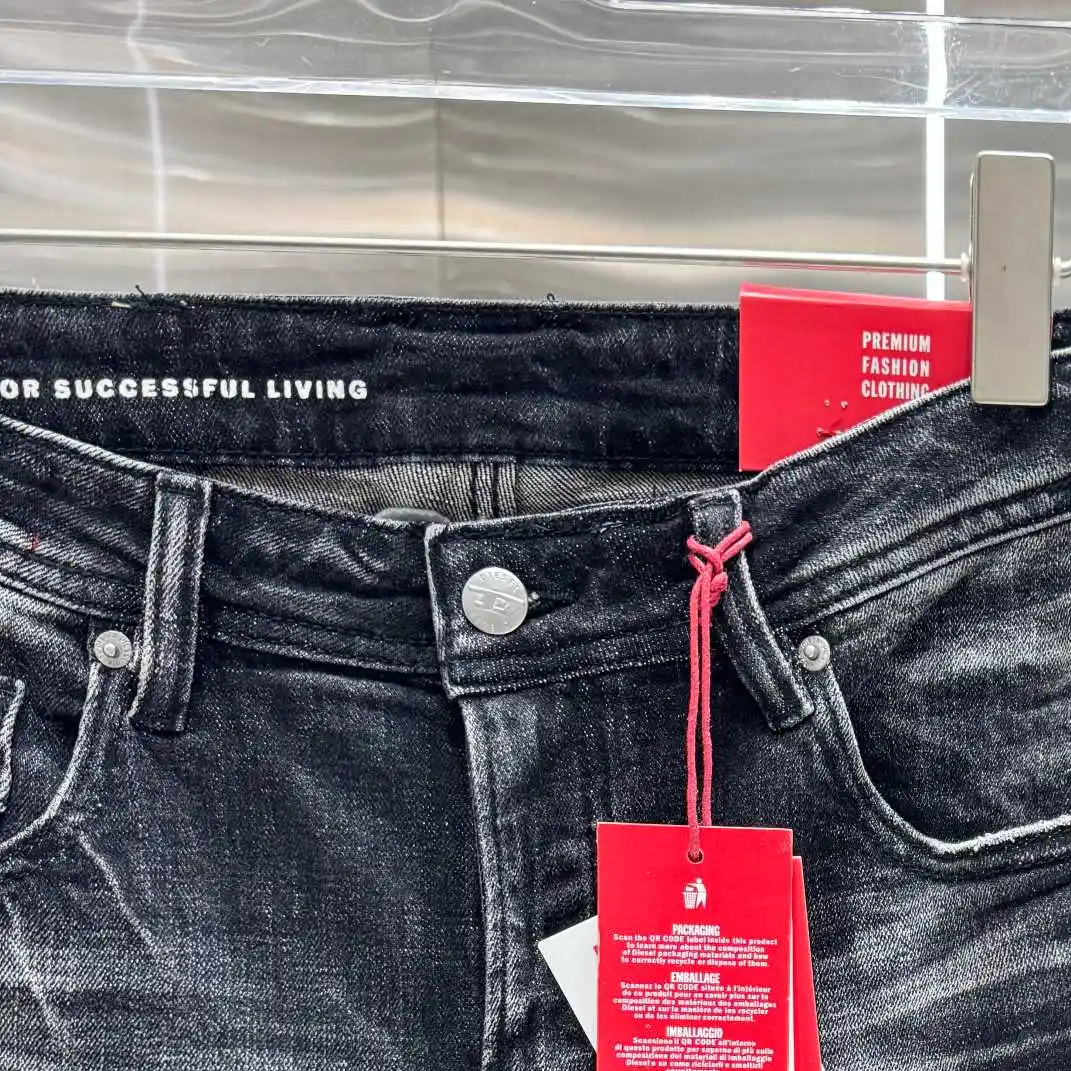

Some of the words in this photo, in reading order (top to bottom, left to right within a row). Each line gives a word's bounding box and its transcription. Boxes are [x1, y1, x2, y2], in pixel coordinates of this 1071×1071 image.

[862, 330, 931, 352] PREMIUM
[862, 356, 930, 377] FASHION
[54, 378, 255, 399] SUCCESSFUL
[267, 379, 368, 400] LIVING
[672, 924, 720, 936] PACKAGING
[614, 933, 632, 941] Scan
[680, 943, 702, 951] about
[671, 971, 720, 984] EMBALLAGE
[666, 1026, 723, 1038] IMBALLAGGIO
